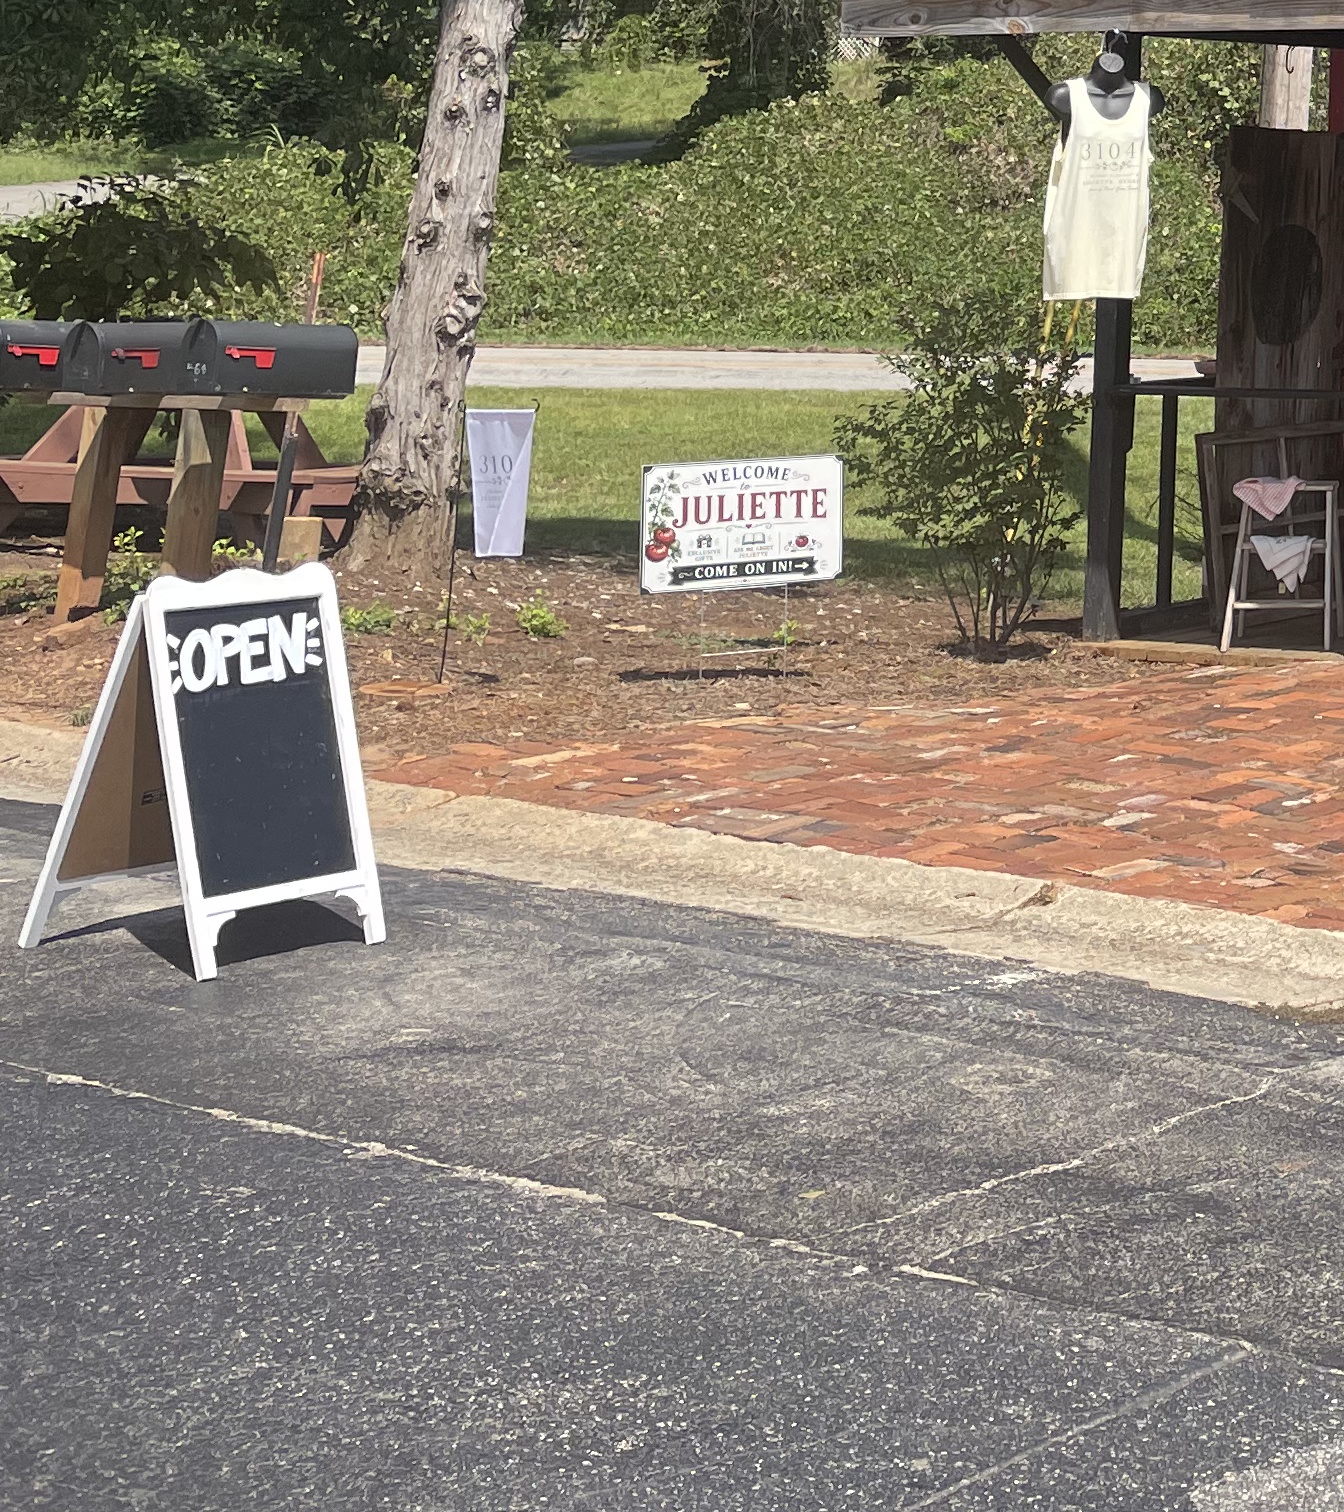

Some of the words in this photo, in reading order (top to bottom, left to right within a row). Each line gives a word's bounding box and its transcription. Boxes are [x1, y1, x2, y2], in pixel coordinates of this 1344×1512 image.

[1081, 141, 1137, 161] 3104
[702, 465, 791, 485] WELCOME
[672, 488, 827, 528] JULIETTE
[694, 564, 738, 579] COME
[745, 562, 766, 575] ON
[772, 560, 793, 573] IN!
[180, 612, 307, 693] OPEN
